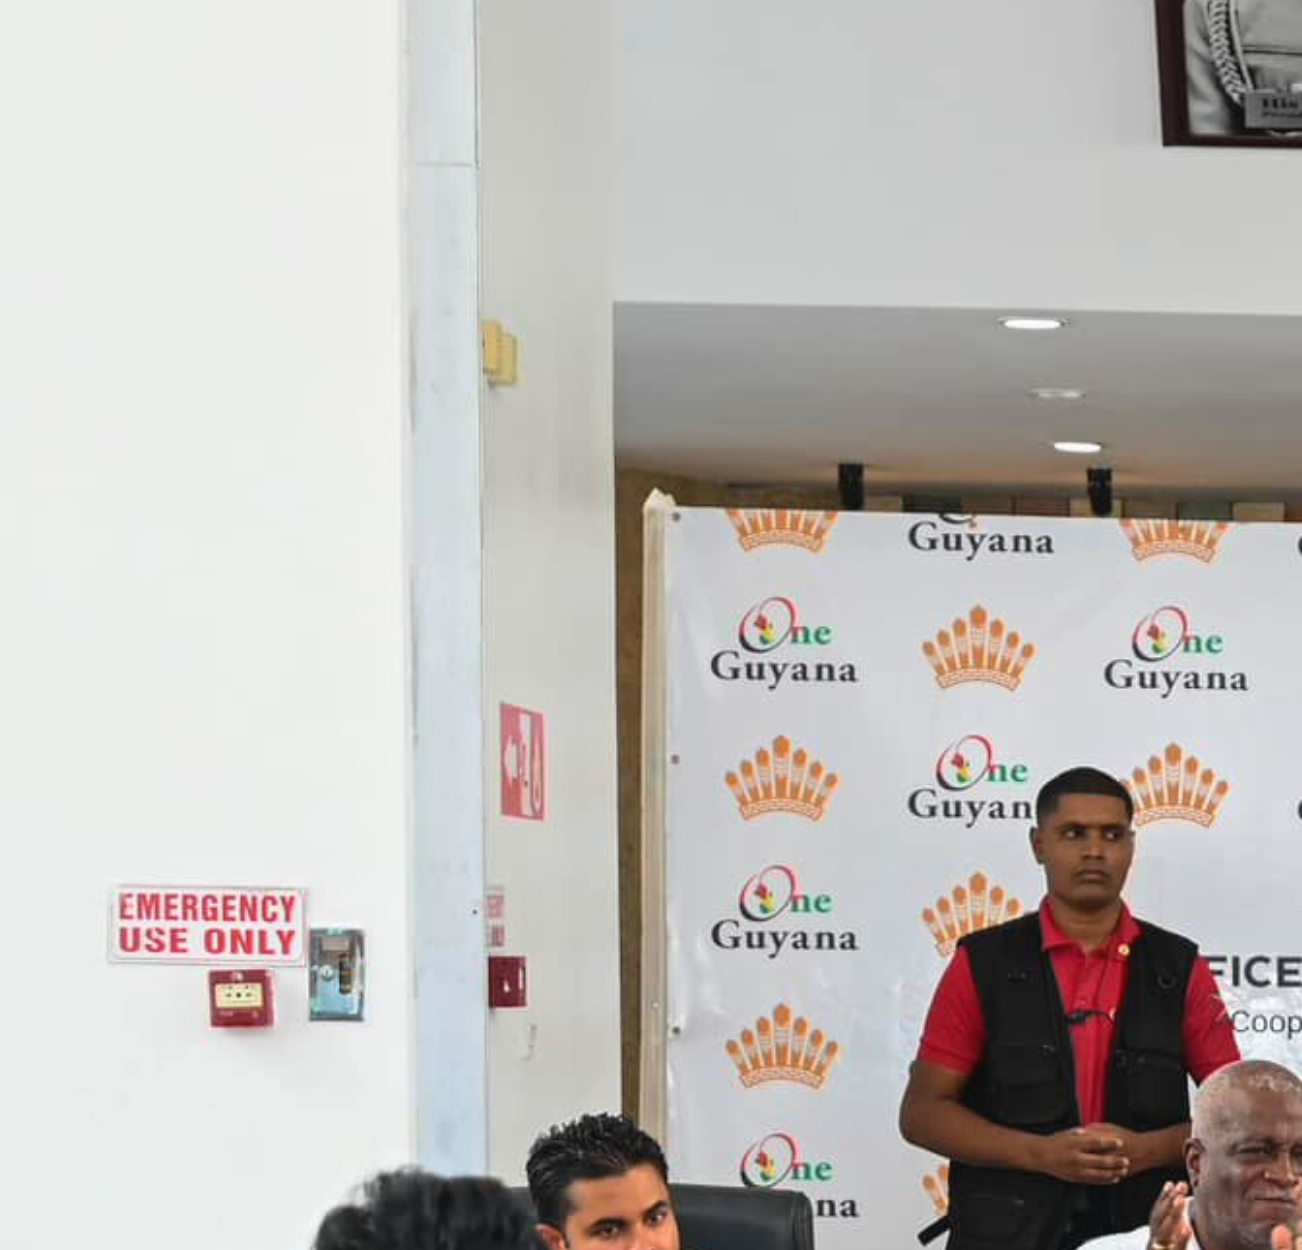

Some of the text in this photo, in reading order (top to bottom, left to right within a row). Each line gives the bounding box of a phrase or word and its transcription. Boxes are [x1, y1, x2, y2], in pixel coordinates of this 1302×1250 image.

[908, 522, 1055, 560] Guyana
[738, 597, 832, 653] One
[1131, 606, 1223, 662] One
[710, 650, 859, 690] Guyana
[1104, 659, 1248, 698] Guyana
[936, 735, 1028, 791] One
[908, 788, 1032, 828] Guyan
[118, 893, 296, 923] EMERGENCY
[738, 865, 832, 921] One
[119, 927, 295, 955] USE ONLY
[710, 920, 859, 958] Guyana
[741, 1132, 832, 1187] One
